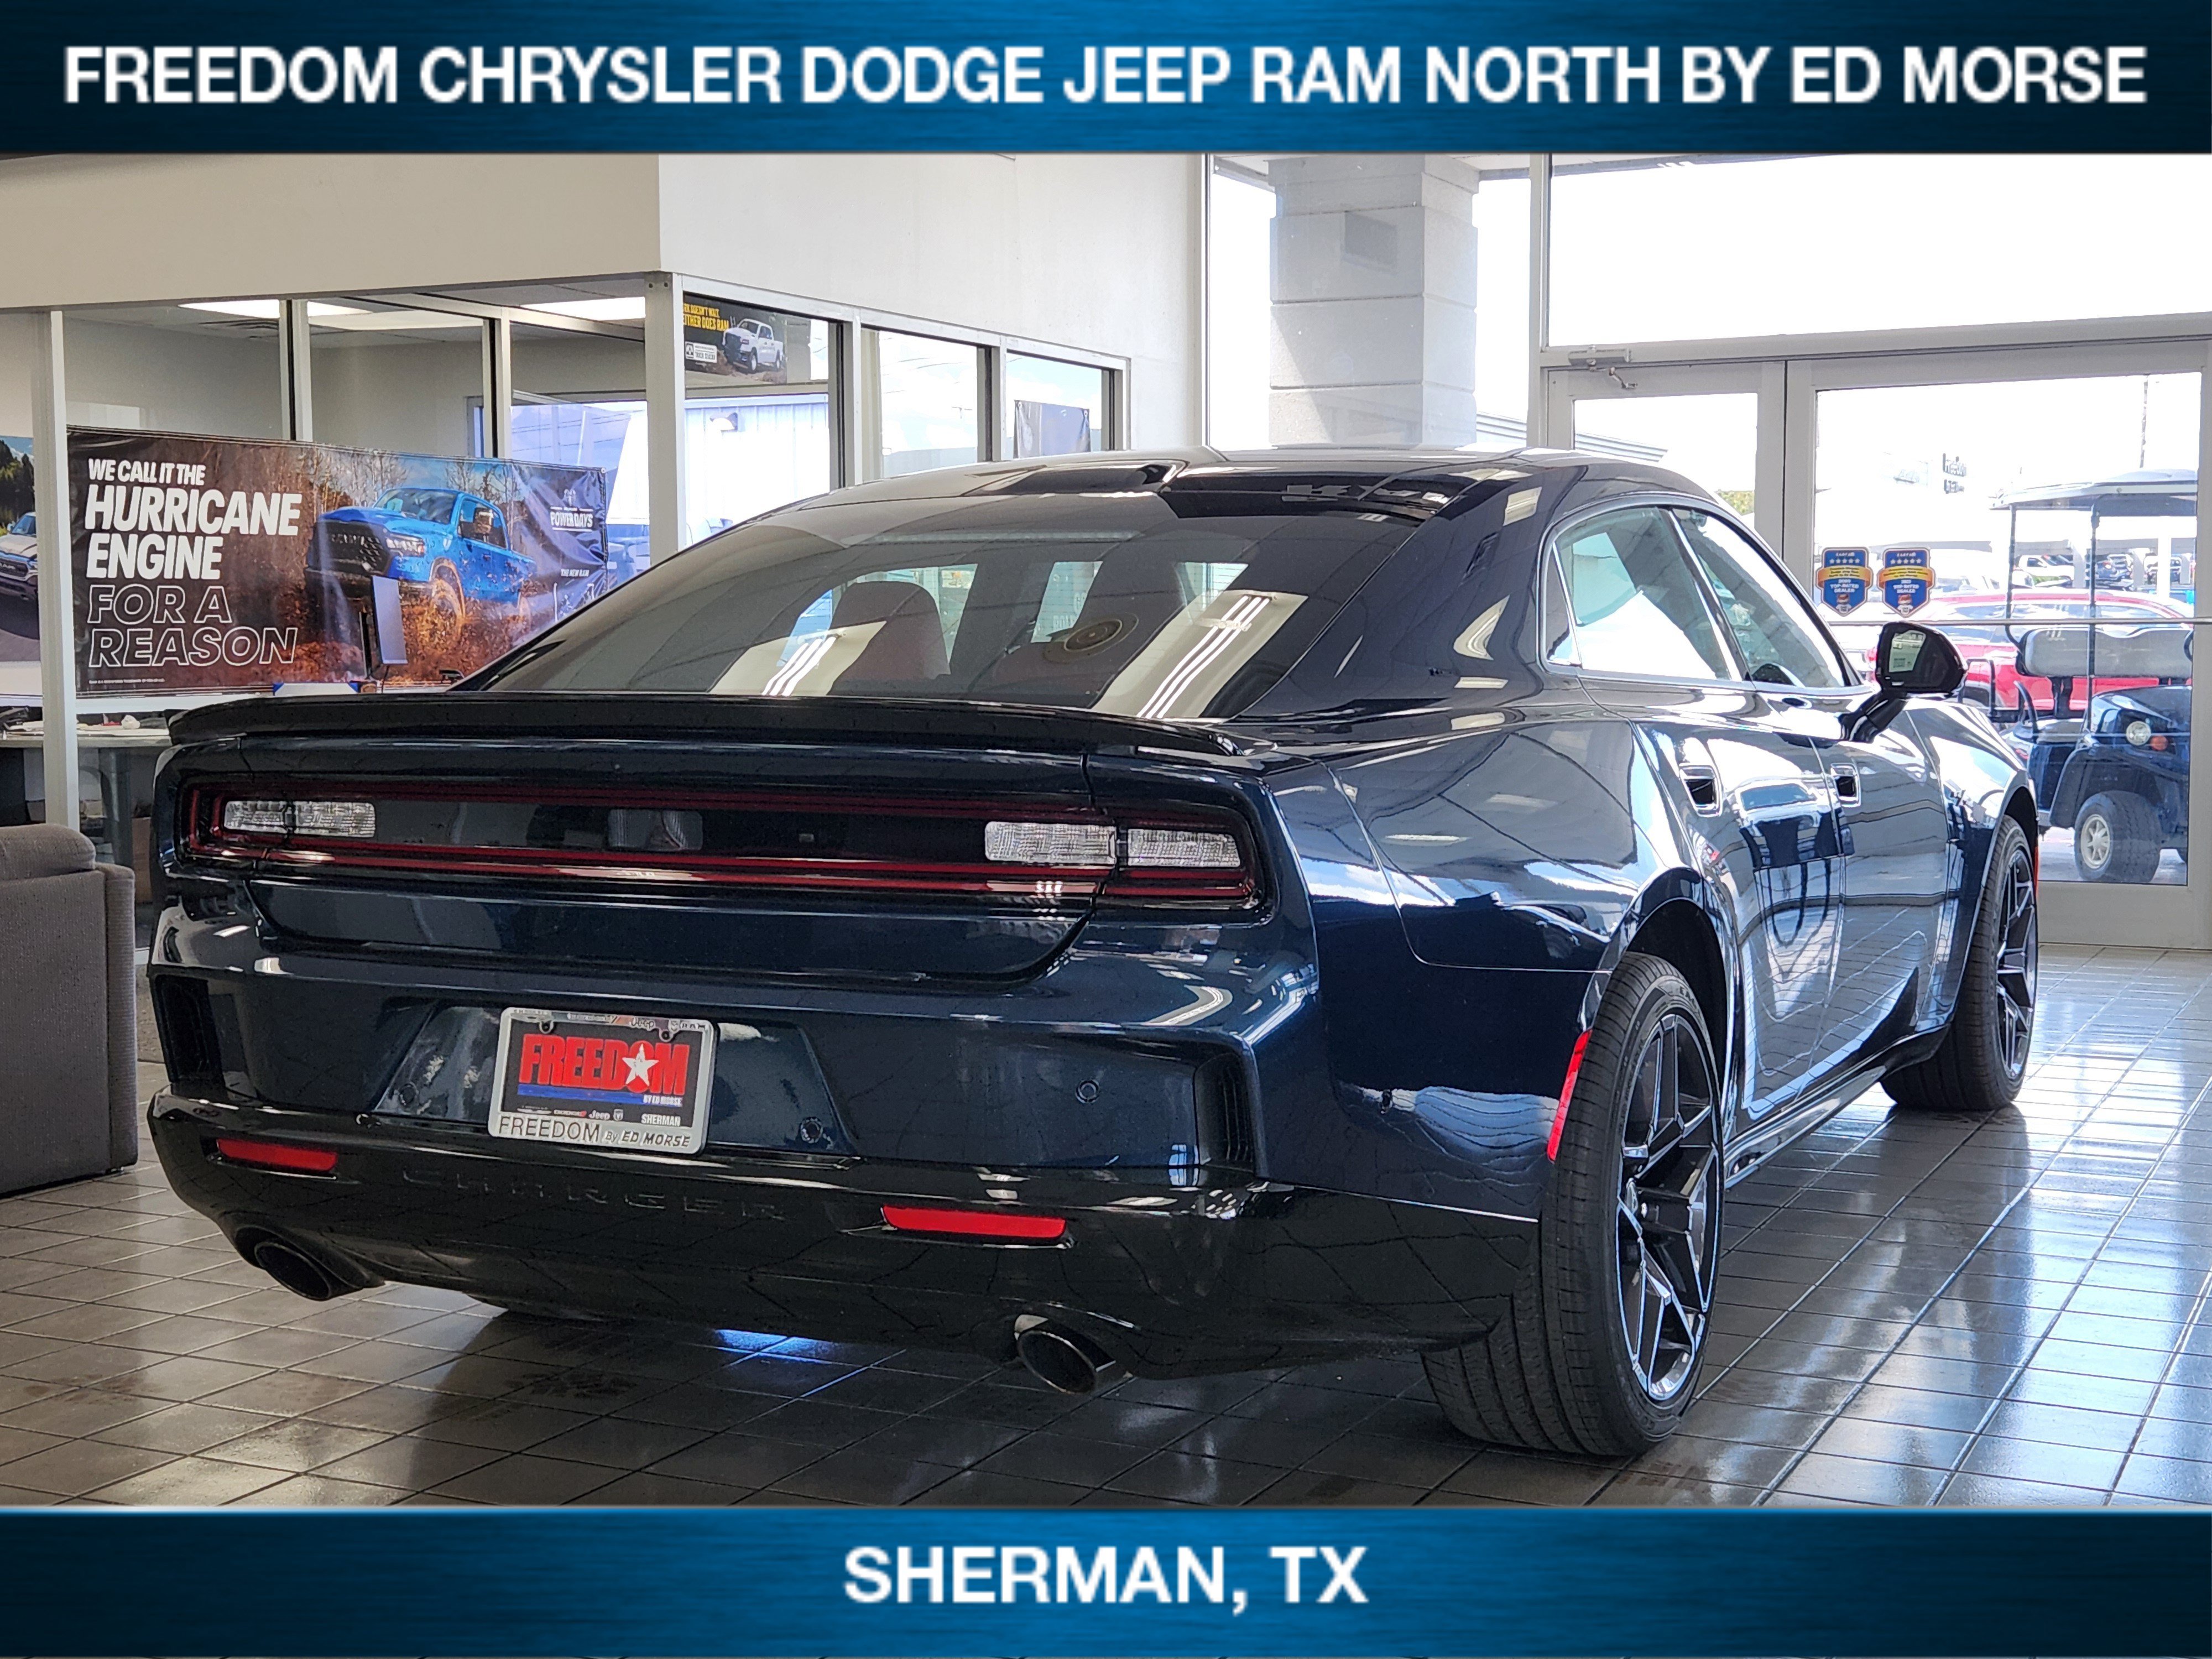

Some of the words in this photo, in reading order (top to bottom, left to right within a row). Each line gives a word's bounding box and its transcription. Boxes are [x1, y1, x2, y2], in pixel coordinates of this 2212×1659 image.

[684, 314, 701, 328] EITHER
[88, 458, 116, 481] WE
[117, 460, 158, 483] CALL
[159, 462, 175, 484] IT
[176, 463, 206, 486] THE
[85, 484, 302, 536] HURRICANE
[550, 512, 574, 527] POWER
[574, 513, 593, 528] DAYS
[86, 533, 224, 580] ENGINE
[87, 583, 186, 625] FOR
[193, 586, 233, 624] A
[88, 626, 298, 667] REASON
[519, 1033, 690, 1095] FREEDOM
[498, 1116, 600, 1142] FREEDOM
[622, 1130, 639, 1142] ED
[643, 1133, 691, 1147] MORSE
[588, 1109, 611, 1120] Jeep
[641, 1113, 681, 1127] SHERMAN
